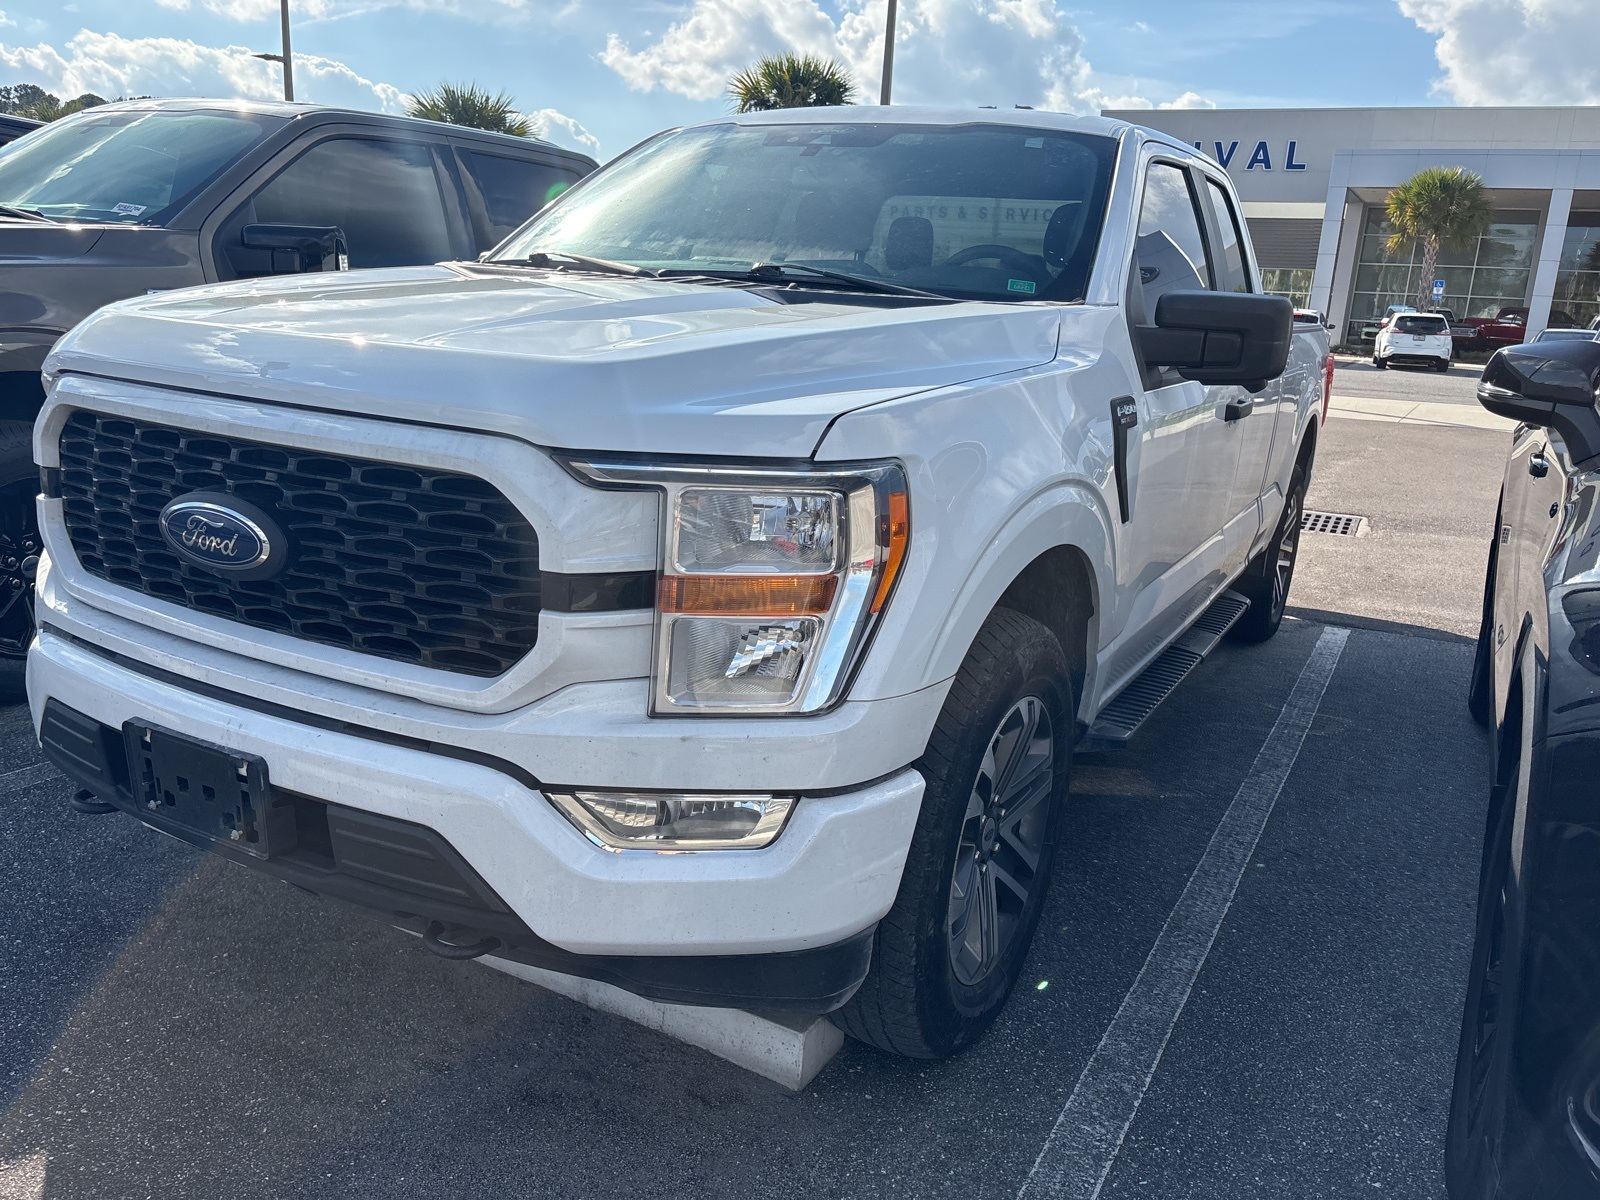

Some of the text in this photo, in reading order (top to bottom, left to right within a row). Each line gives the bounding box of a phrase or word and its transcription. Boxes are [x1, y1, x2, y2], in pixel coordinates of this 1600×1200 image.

[1194, 140, 1307, 171] VAL
[890, 206, 948, 219] PARTS
[957, 206, 967, 219] &
[182, 514, 239, 557] Ford
